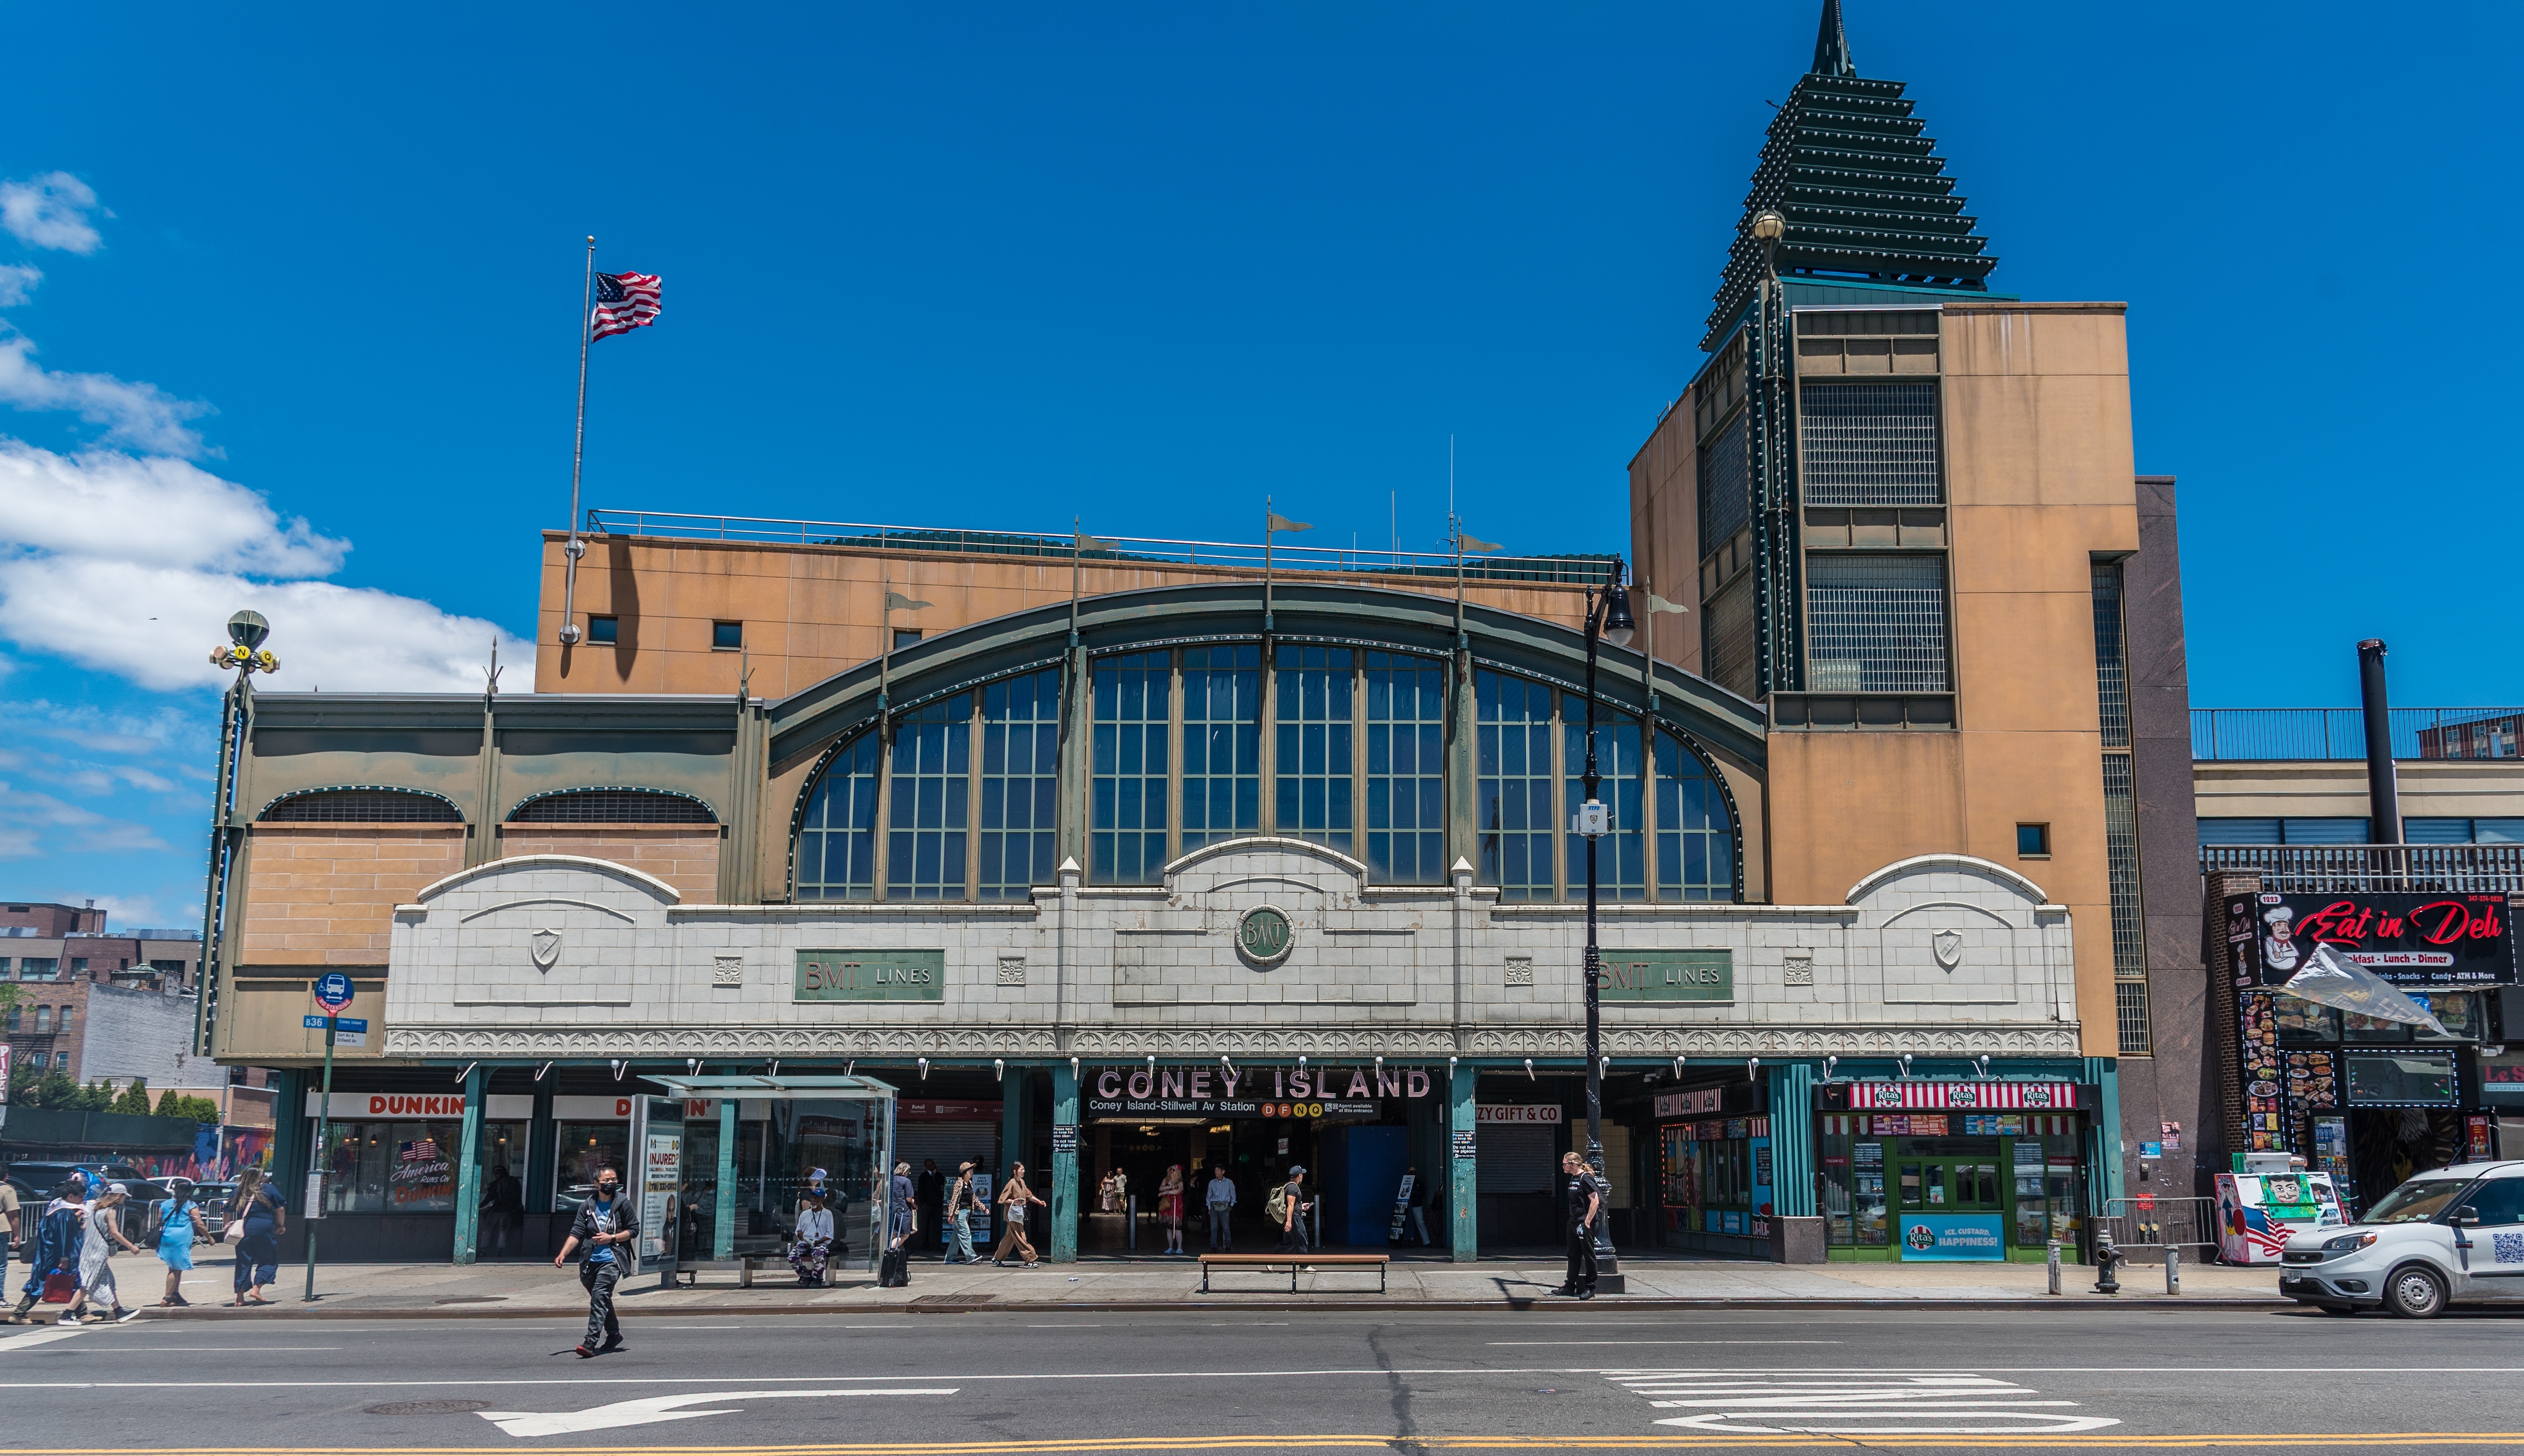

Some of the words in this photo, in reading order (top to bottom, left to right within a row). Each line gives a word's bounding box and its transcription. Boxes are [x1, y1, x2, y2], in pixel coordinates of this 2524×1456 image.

[264, 653, 271, 661] Q
[2228, 920, 2236, 935] Eat
[2240, 917, 2250, 932] Deli
[2294, 901, 2373, 948] Eat
[2376, 911, 2404, 938] in
[2409, 900, 2503, 945] Deli
[1246, 917, 1283, 949] BMT
[2383, 954, 2410, 963] Lunch
[2418, 954, 2448, 963] Dinner
[806, 961, 861, 989] BMT
[876, 968, 931, 984] LINES
[1598, 962, 1649, 989] BMT
[1665, 968, 1719, 984] LINES
[2431, 972, 2451, 981] Candy
[319, 998, 326, 1006] NO
[326, 1000, 350, 1011] STANDING
[306, 1017, 323, 1027] B36
[2484, 1066, 2509, 1082] Le
[2512, 1066, 2524, 1082] S
[1098, 1071, 1242, 1099] CONEY
[1275, 1071, 1430, 1098] ISLAND
[1879, 1091, 1899, 1100] Rita's
[1953, 1091, 1973, 1100] Rita's
[2027, 1091, 2047, 1100] Rita's
[1090, 1100, 1122, 1112] Coney
[1127, 1100, 1197, 1111] Island-Stillwell
[1202, 1102, 1215, 1111] Av
[1220, 1102, 1255, 1111] Station
[1312, 1107, 1319, 1115] Q
[1495, 1107, 1525, 1121] GIFT
[1526, 1107, 1537, 1121] &
[1540, 1107, 1557, 1121] CO
[649, 1153, 679, 1165] INJURED?
[390, 1161, 450, 1182] America
[395, 1184, 455, 1203] DUNKIN'
[1910, 1233, 1933, 1243] Rita's
[1958, 1228, 1991, 1236] CUSTARD,
[1939, 1237, 1998, 1247] HAPPINESS!
